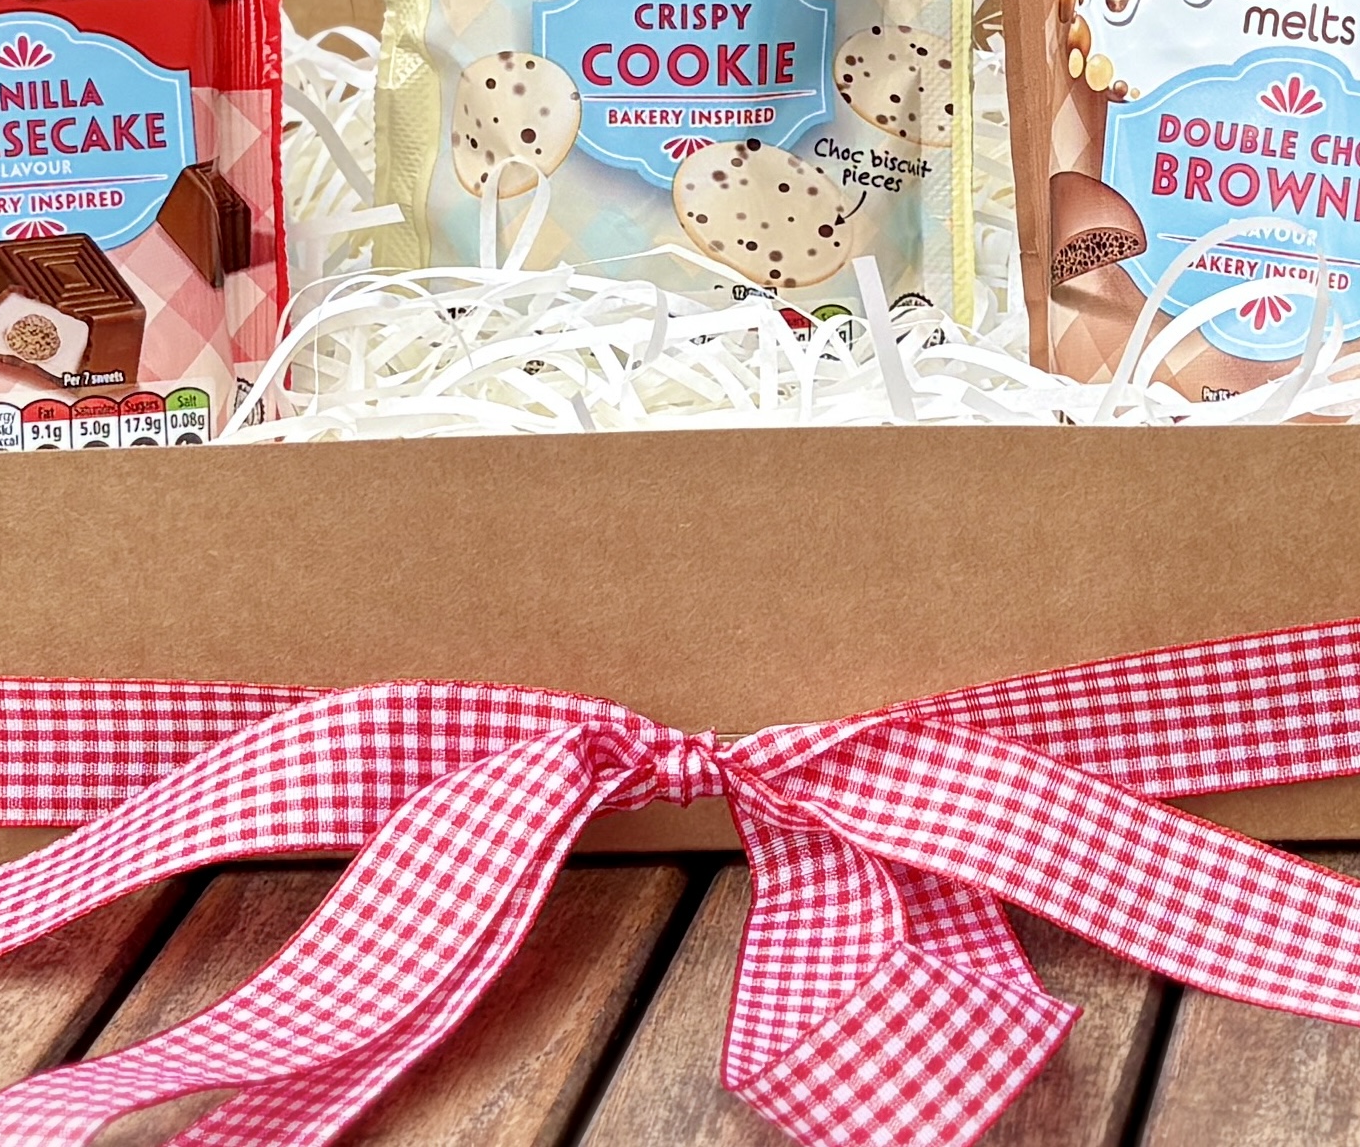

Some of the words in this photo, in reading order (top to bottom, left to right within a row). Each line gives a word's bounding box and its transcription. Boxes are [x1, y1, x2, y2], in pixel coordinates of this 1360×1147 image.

[634, 3, 753, 31] CRISPY
[1243, 3, 1356, 44] melts
[581, 42, 796, 87] COOKIE
[608, 108, 684, 128] BAKERY
[690, 106, 775, 127] INSPIRED
[1157, 113, 1299, 160] DOUBLE
[815, 138, 865, 165] Choc
[869, 152, 933, 180] biscuit
[842, 167, 903, 194] pieces
[30, 189, 125, 213] INSPIRED
[1238, 226, 1318, 247] AVOUR
[1187, 254, 1259, 279] AKERY
[63, 373, 82, 388] Per
[83, 372, 91, 386] 7
[91, 371, 125, 385] sweets
[124, 399, 160, 413] Sugars
[177, 395, 197, 408] Salt
[38, 406, 55, 419] Fat
[170, 413, 205, 430] 0.08g
[31, 424, 62, 441] 9.1g
[80, 421, 111, 438] 5.0g
[125, 416, 162, 434] 17.9g
